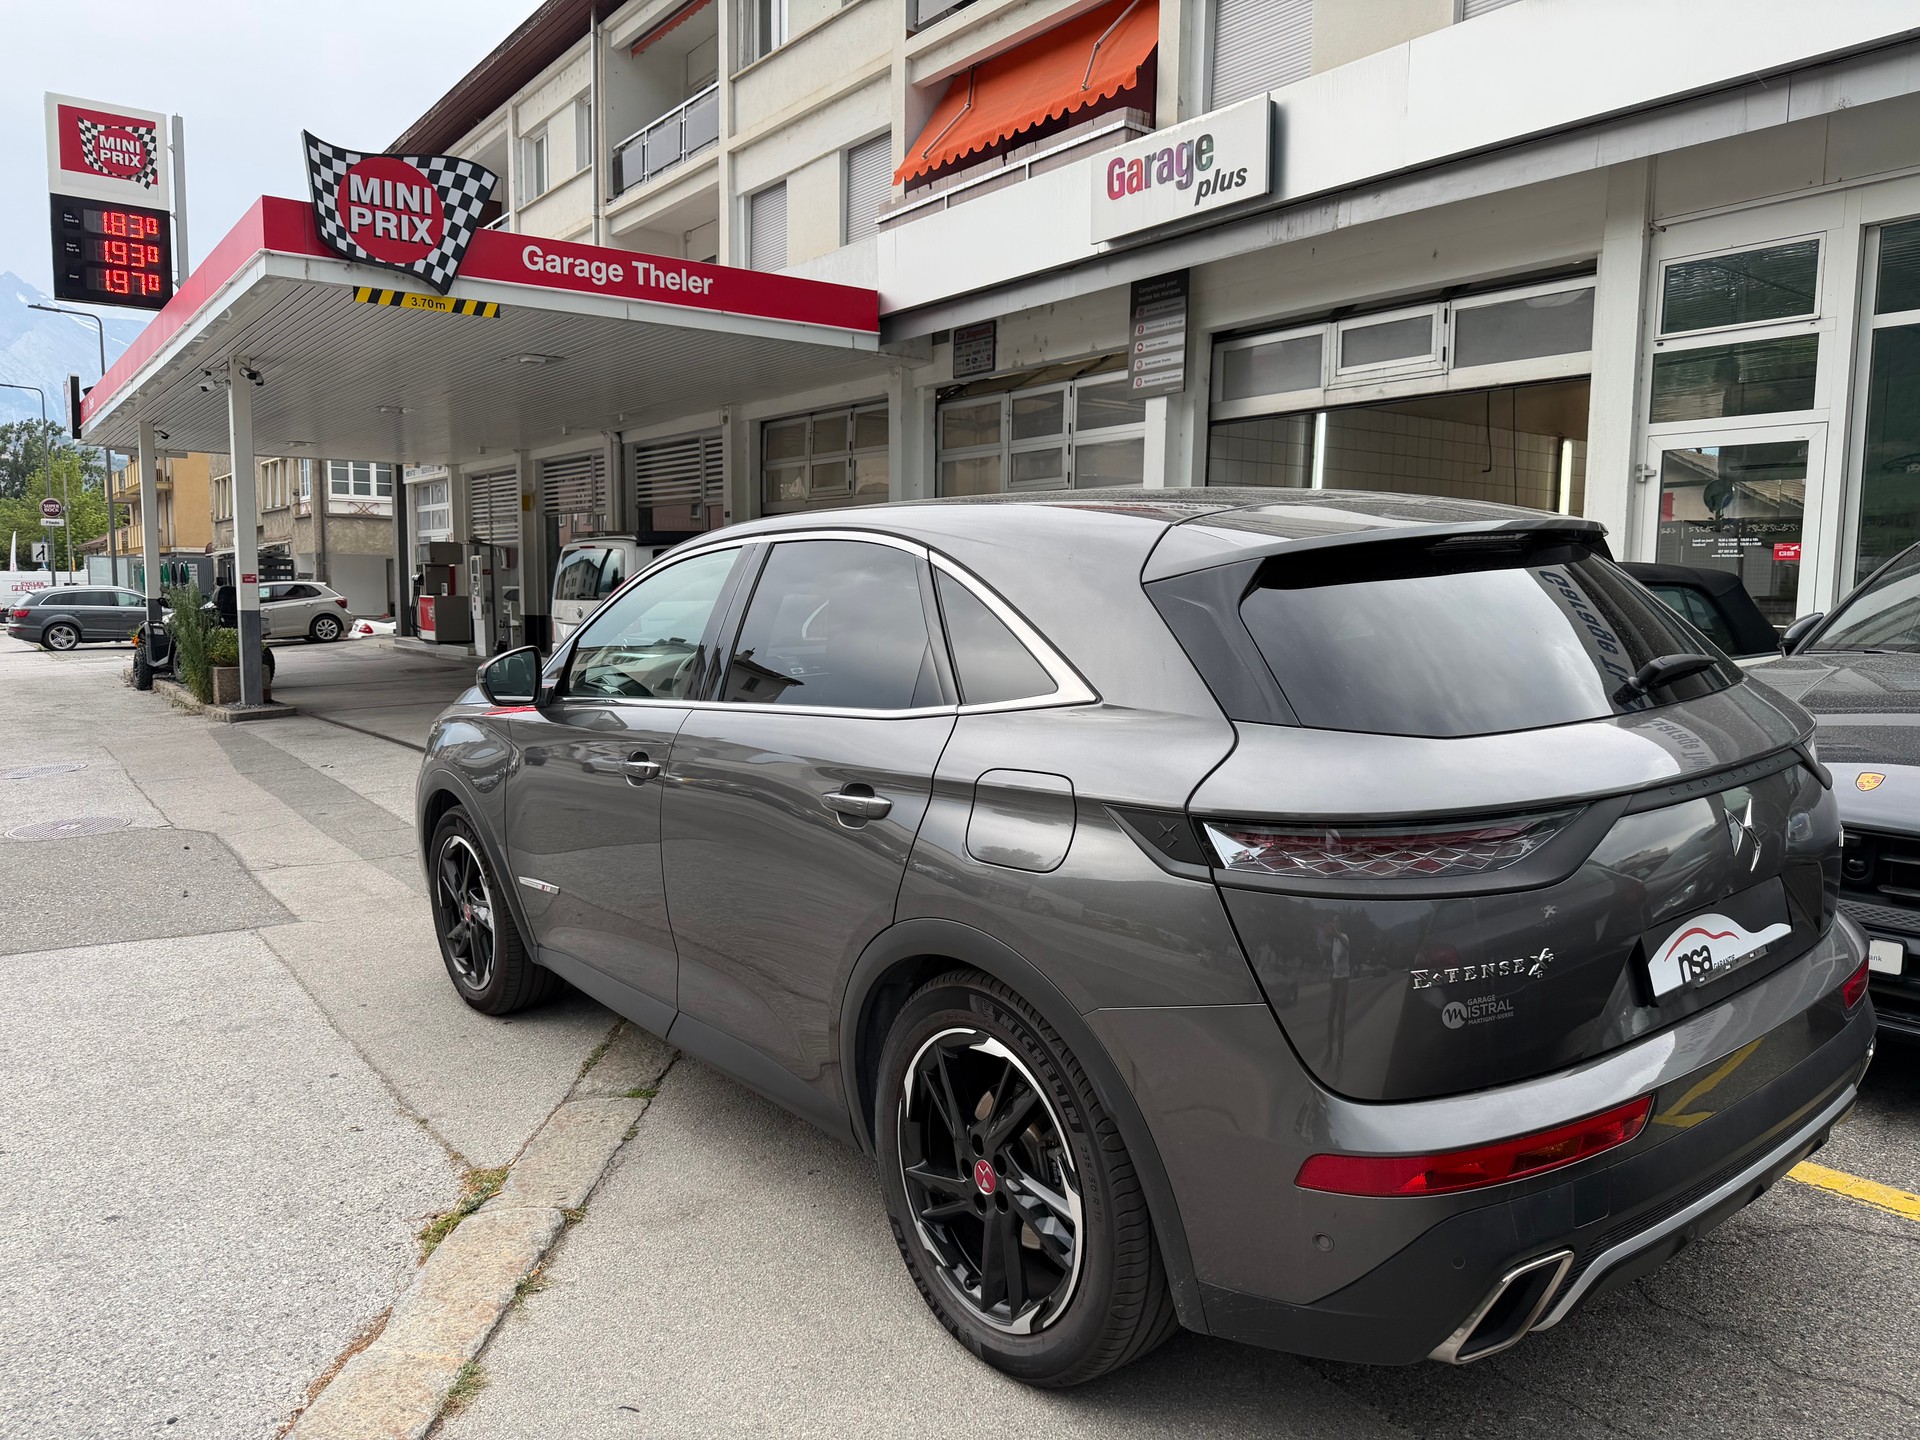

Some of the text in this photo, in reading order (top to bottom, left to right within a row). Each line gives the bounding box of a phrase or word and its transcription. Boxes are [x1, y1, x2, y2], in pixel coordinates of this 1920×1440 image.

[100, 134, 141, 154] MINI
[100, 151, 141, 168] PRIX
[1107, 133, 1214, 200] Garage
[350, 174, 432, 215] MINI
[1194, 167, 1248, 206] plus
[350, 206, 434, 245] PRIX
[522, 245, 713, 295] Garage Theler
[1678, 945, 1713, 984] nsa
[1468, 995, 1496, 1005] GARAGE
[1468, 1011, 1514, 1025] MARTIGNY-SIERRE
[1000, 1014, 1080, 1125] MICHELIN
